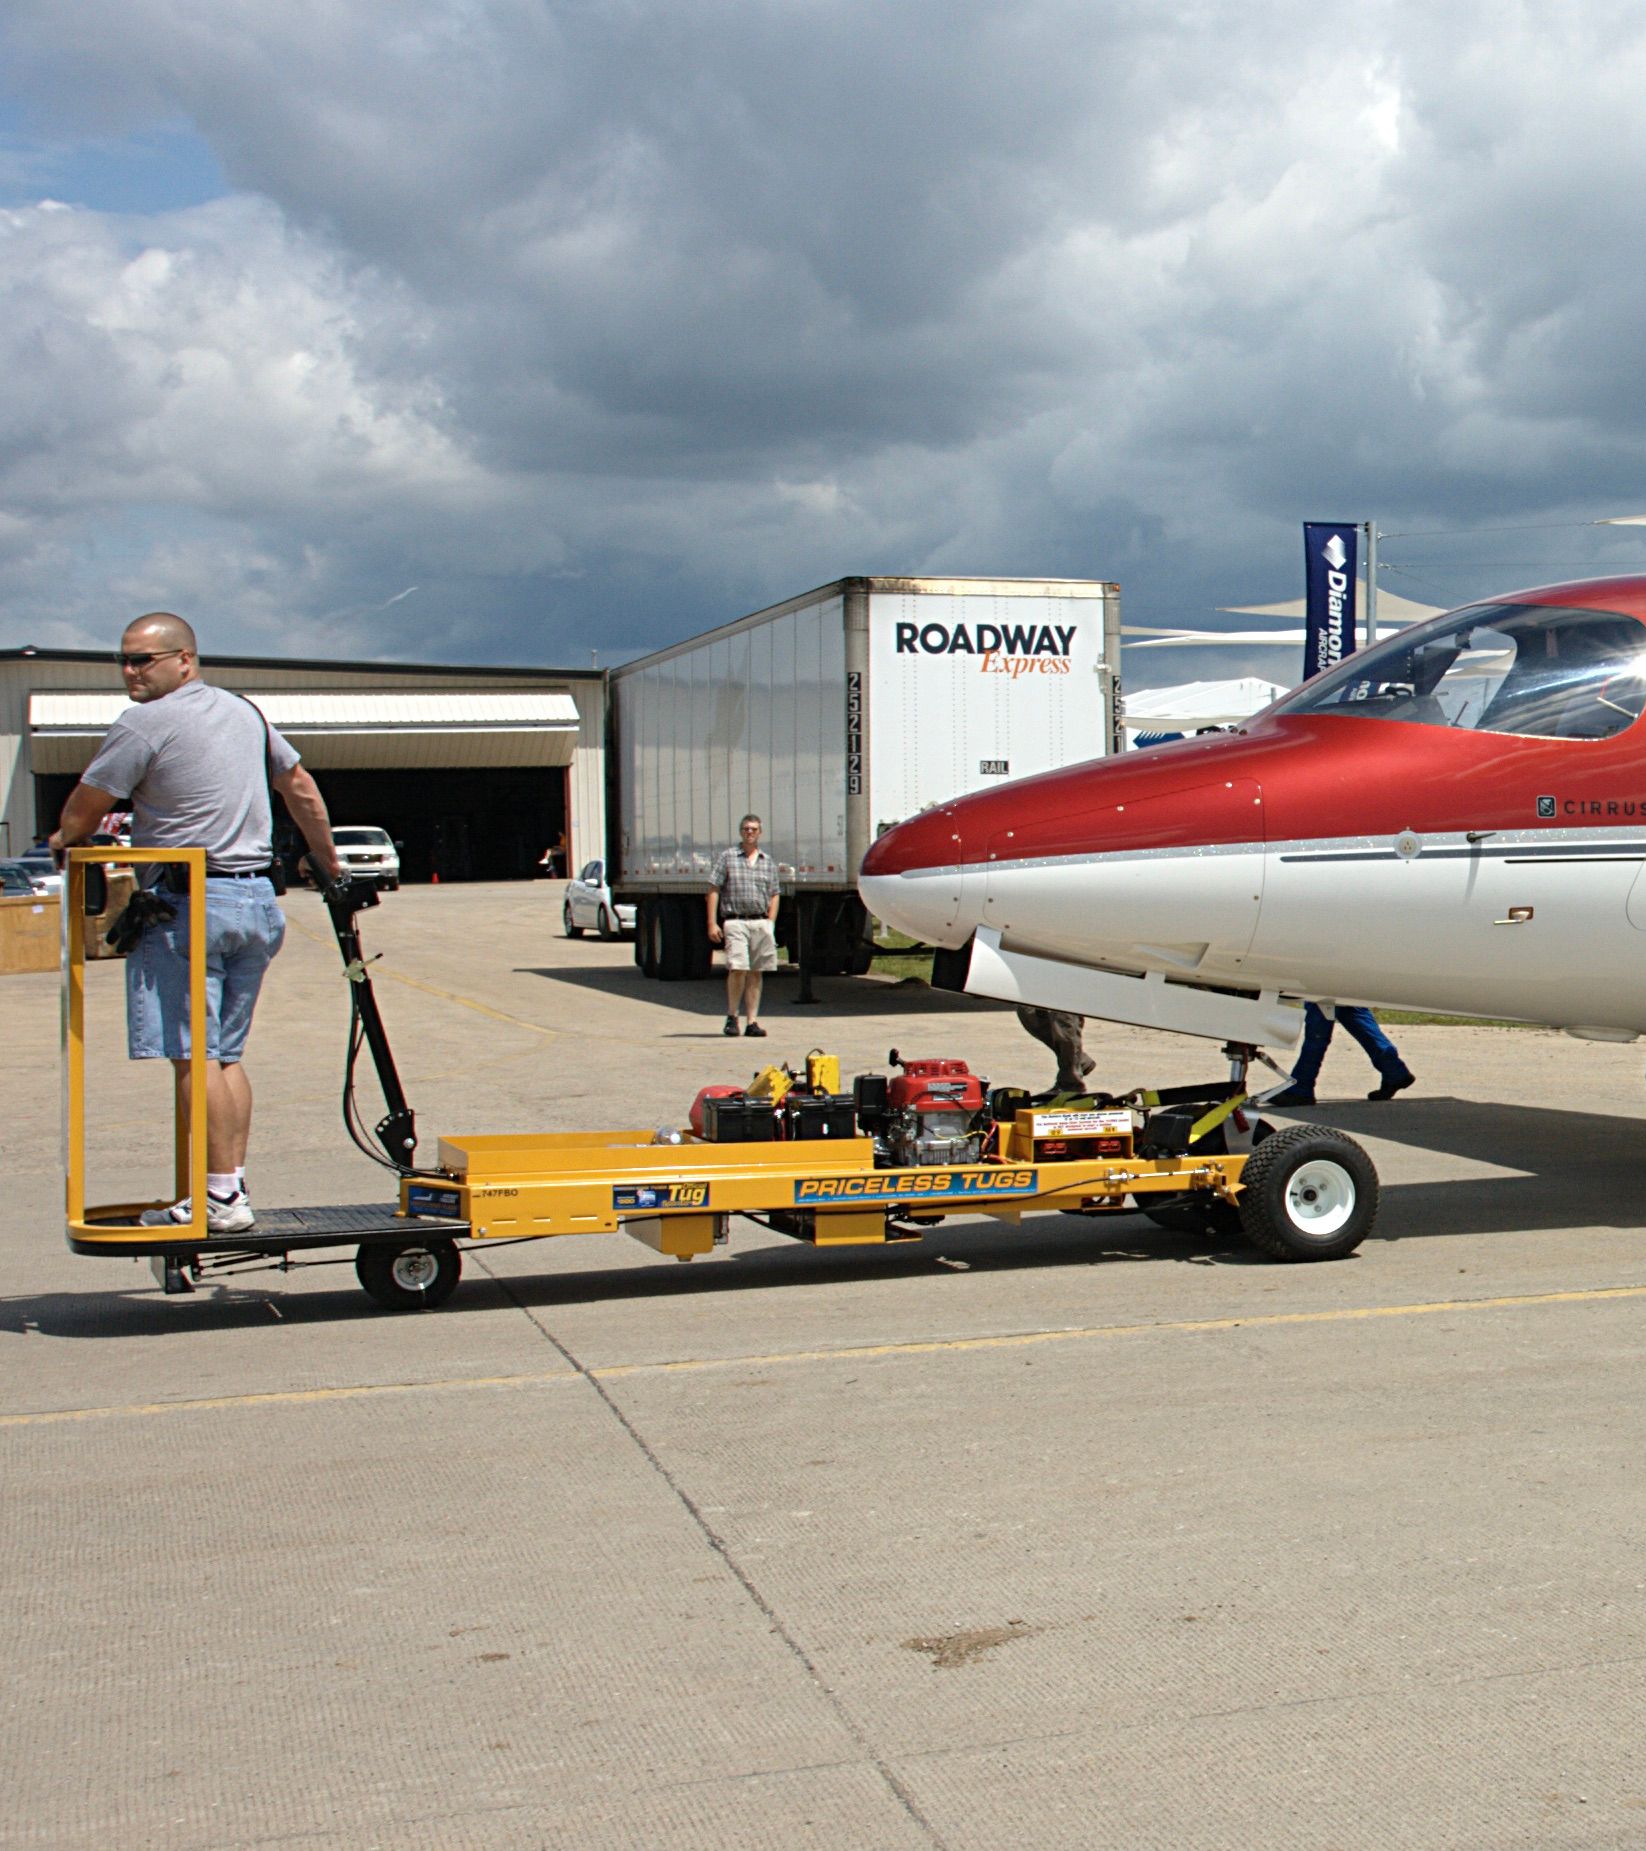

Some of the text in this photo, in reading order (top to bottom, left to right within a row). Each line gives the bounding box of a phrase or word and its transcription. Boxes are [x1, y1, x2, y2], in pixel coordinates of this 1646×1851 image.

[896, 622, 1077, 656] ROADWAY
[980, 650, 1072, 680] Express
[849, 673, 860, 794] 252129
[981, 761, 1009, 774] RAIL
[668, 1184, 706, 1206] Tug
[799, 1174, 951, 1197] PRICELESS
[962, 1171, 1032, 1189] TUGS
